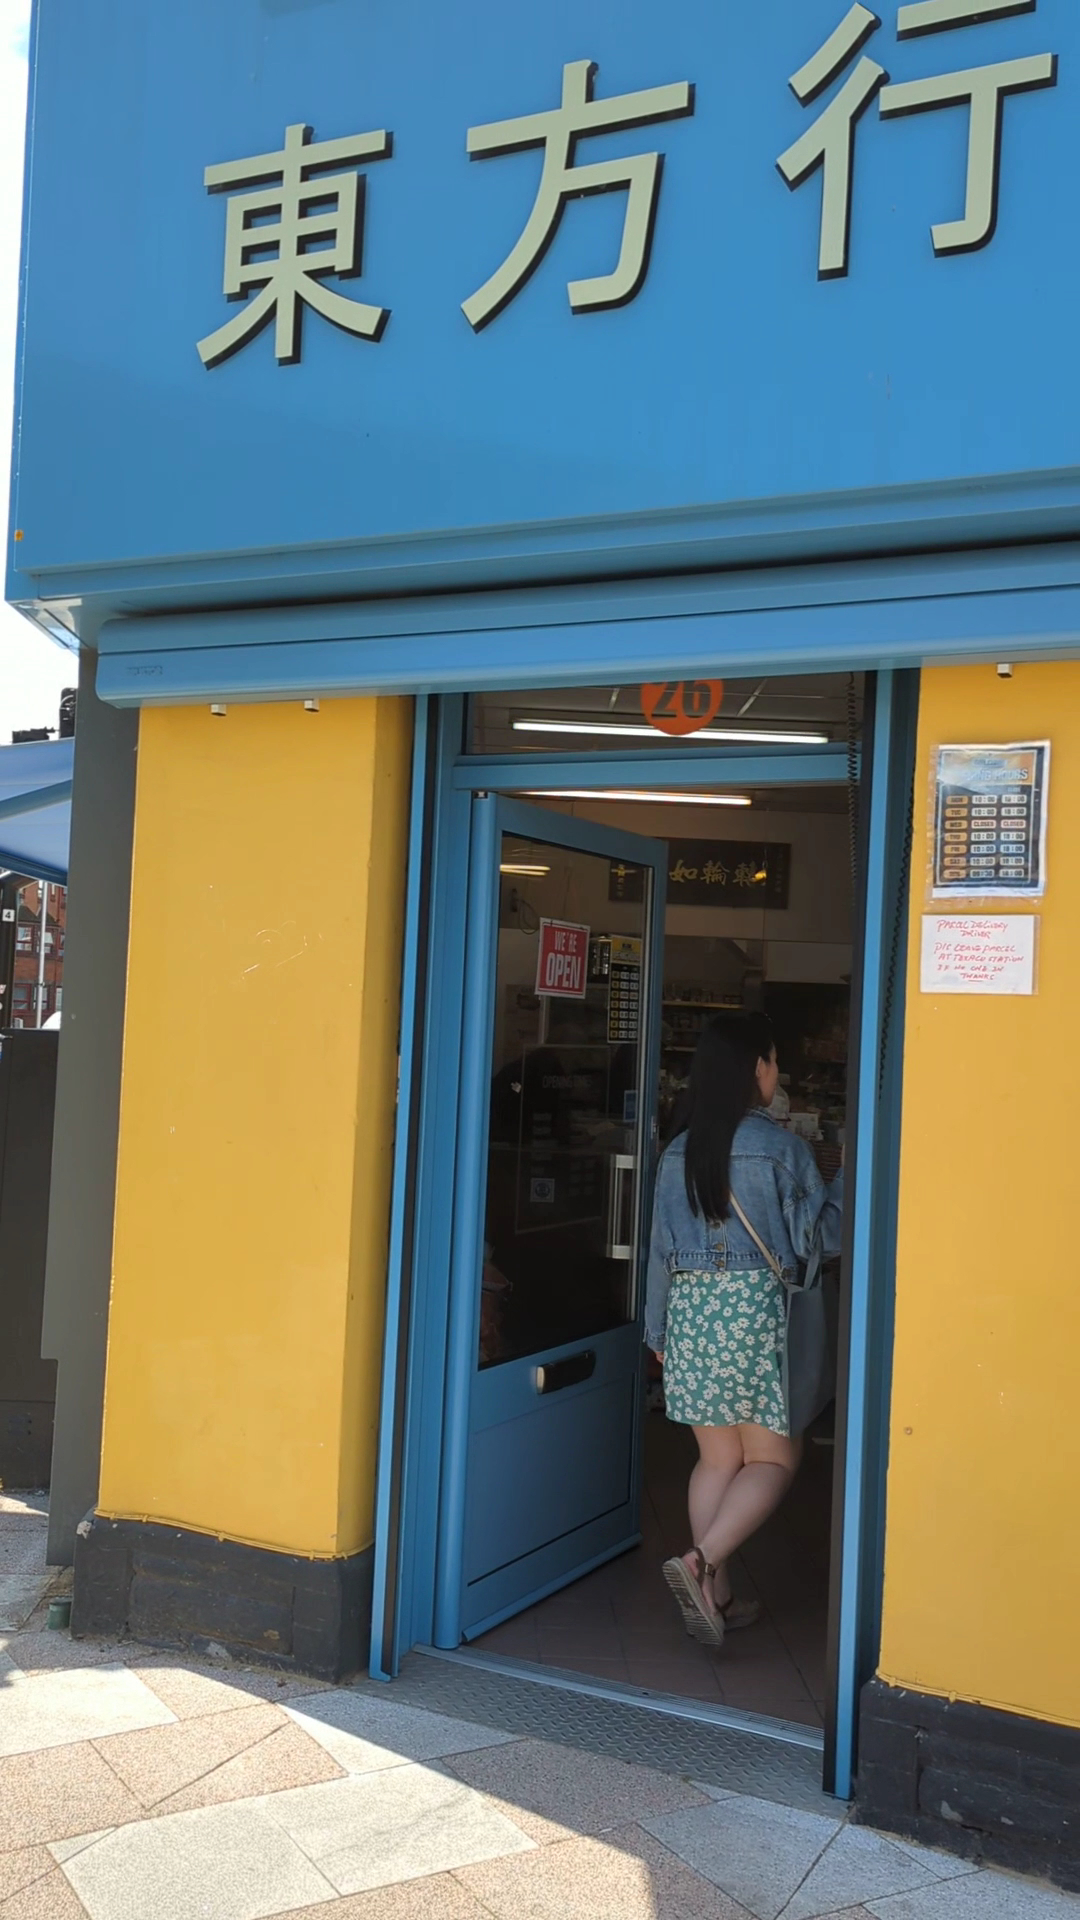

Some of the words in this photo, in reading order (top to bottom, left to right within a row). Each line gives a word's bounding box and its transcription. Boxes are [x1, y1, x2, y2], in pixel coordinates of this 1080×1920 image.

[197, 0, 1058, 368] 東方行
[651, 681, 711, 720] 26
[555, 930, 577, 952] WE'RE
[546, 952, 581, 989] OPEN
[542, 1075, 572, 1088] OPENING
